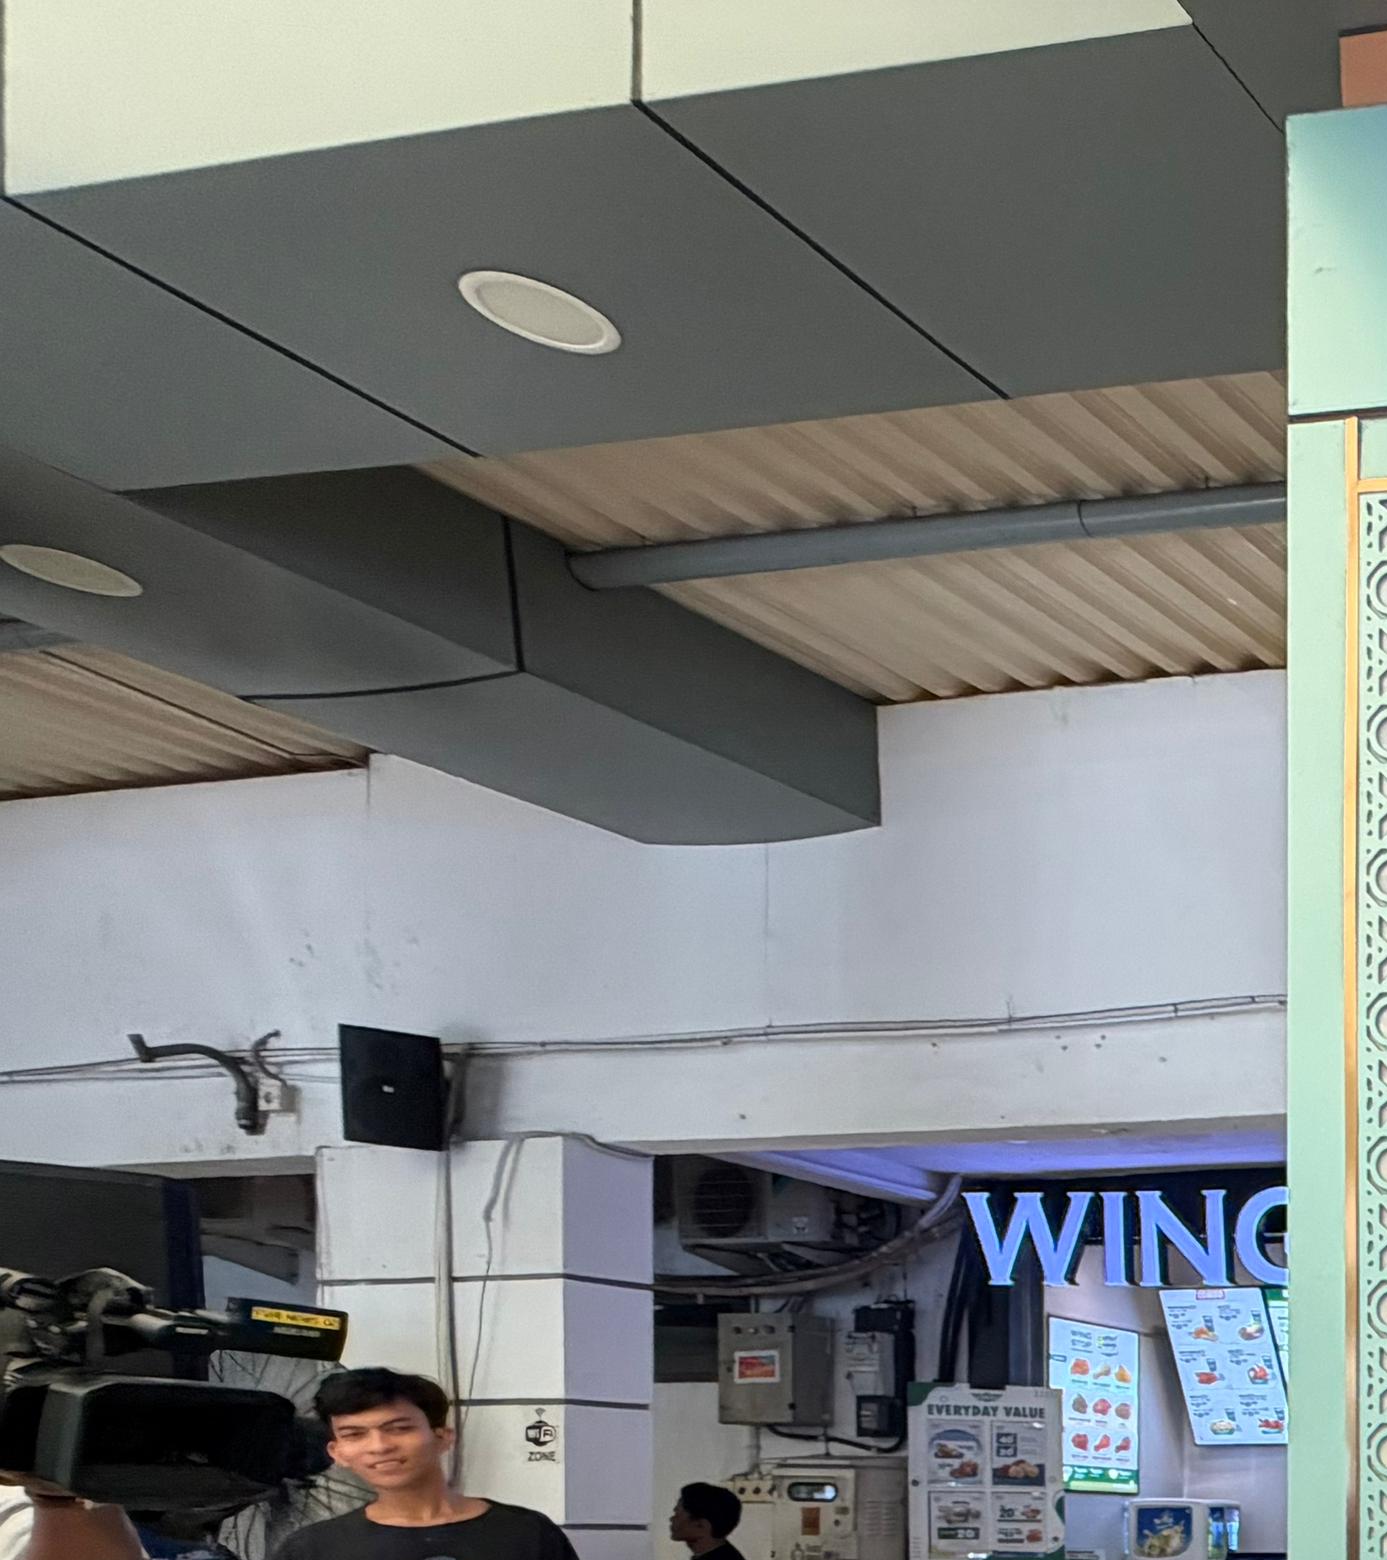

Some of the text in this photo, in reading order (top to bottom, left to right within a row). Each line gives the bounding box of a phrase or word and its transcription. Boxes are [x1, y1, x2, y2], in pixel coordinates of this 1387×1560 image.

[962, 1186, 1289, 1286] WING
[927, 1403, 1046, 1419] EVERYDAY VALUE
[527, 1451, 556, 1462] ZONE
